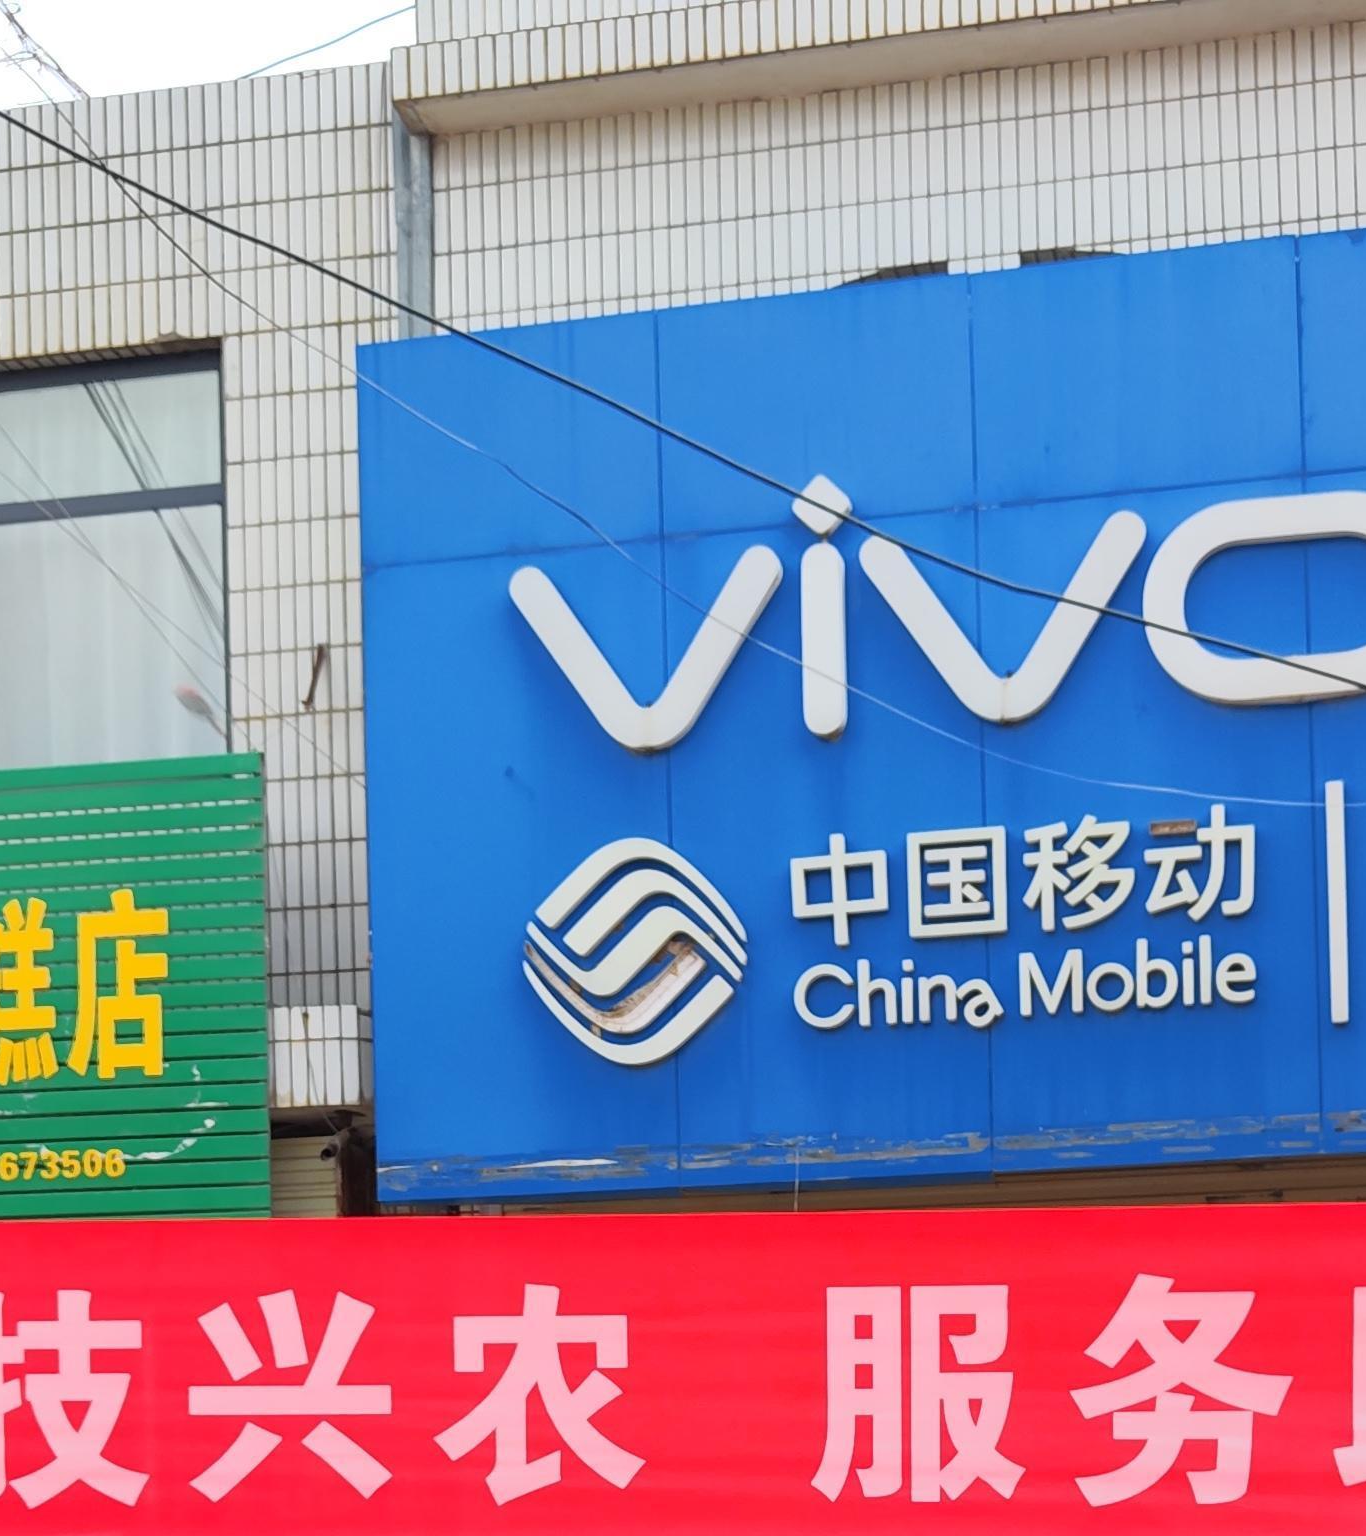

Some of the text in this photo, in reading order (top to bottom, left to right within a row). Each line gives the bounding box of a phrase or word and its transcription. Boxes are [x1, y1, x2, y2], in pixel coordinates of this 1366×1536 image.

[789, 803, 1256, 947] 中国移动
[793, 934, 1257, 1029] China Mobile
